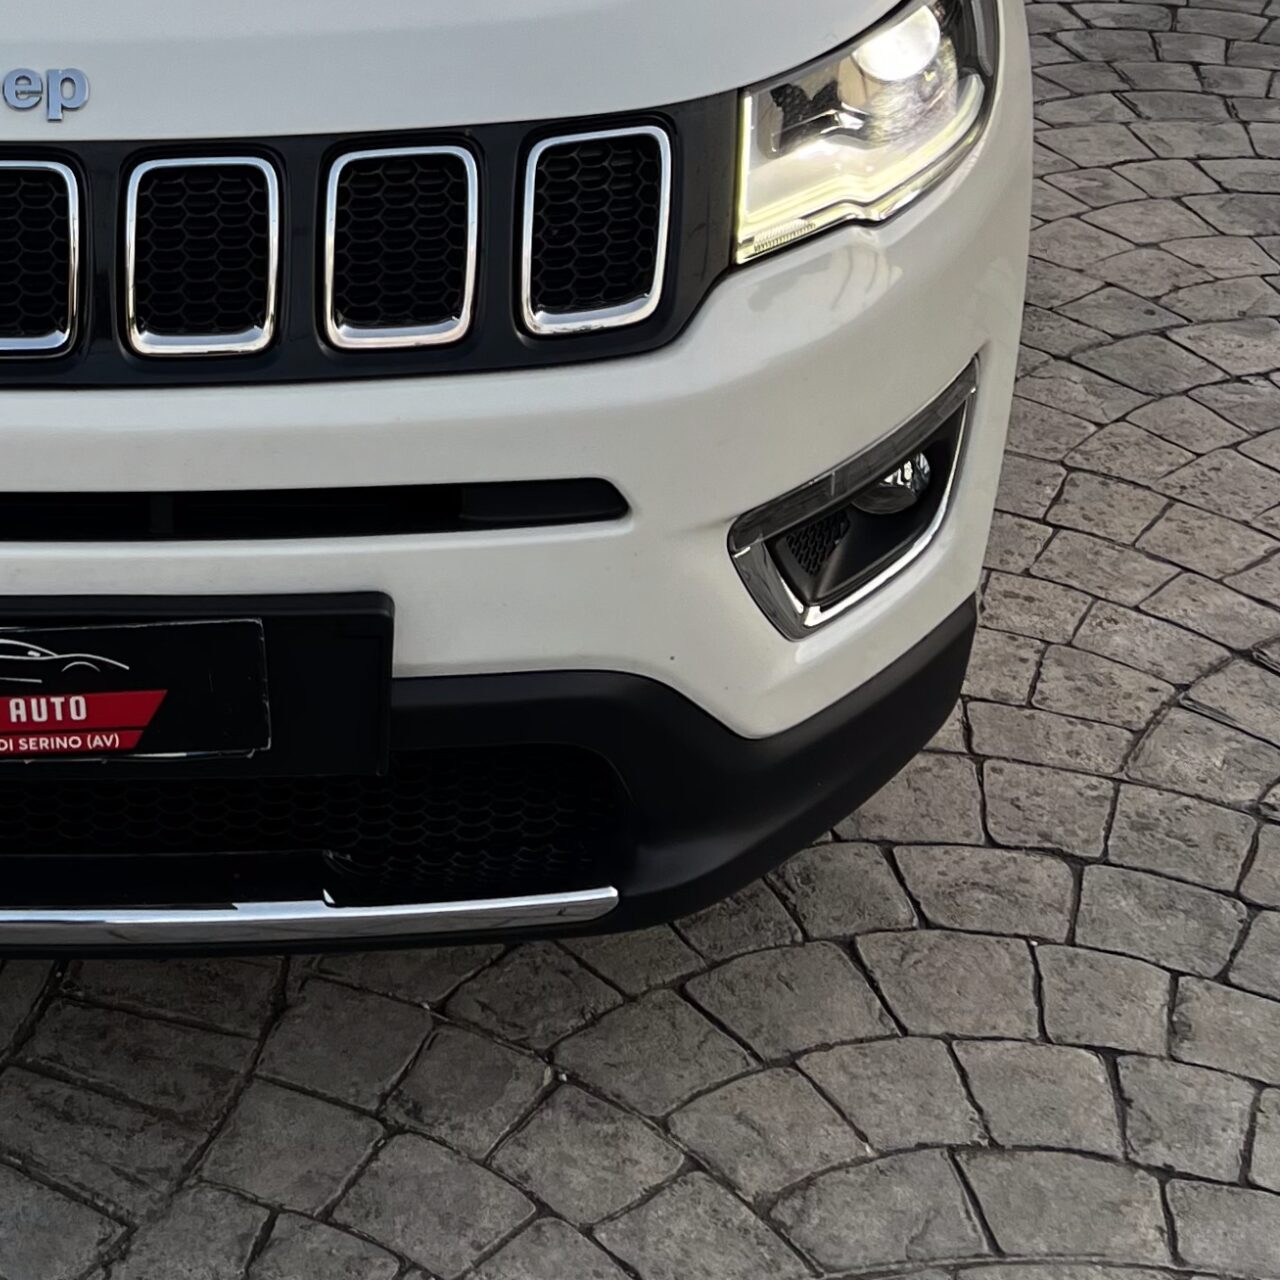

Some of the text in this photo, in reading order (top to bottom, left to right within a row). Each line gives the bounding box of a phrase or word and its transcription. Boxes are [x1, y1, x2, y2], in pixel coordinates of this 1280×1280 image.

[9, 695, 88, 723] AUTO
[18, 736, 82, 752] SERINO
[87, 733, 120, 750] (AV)
